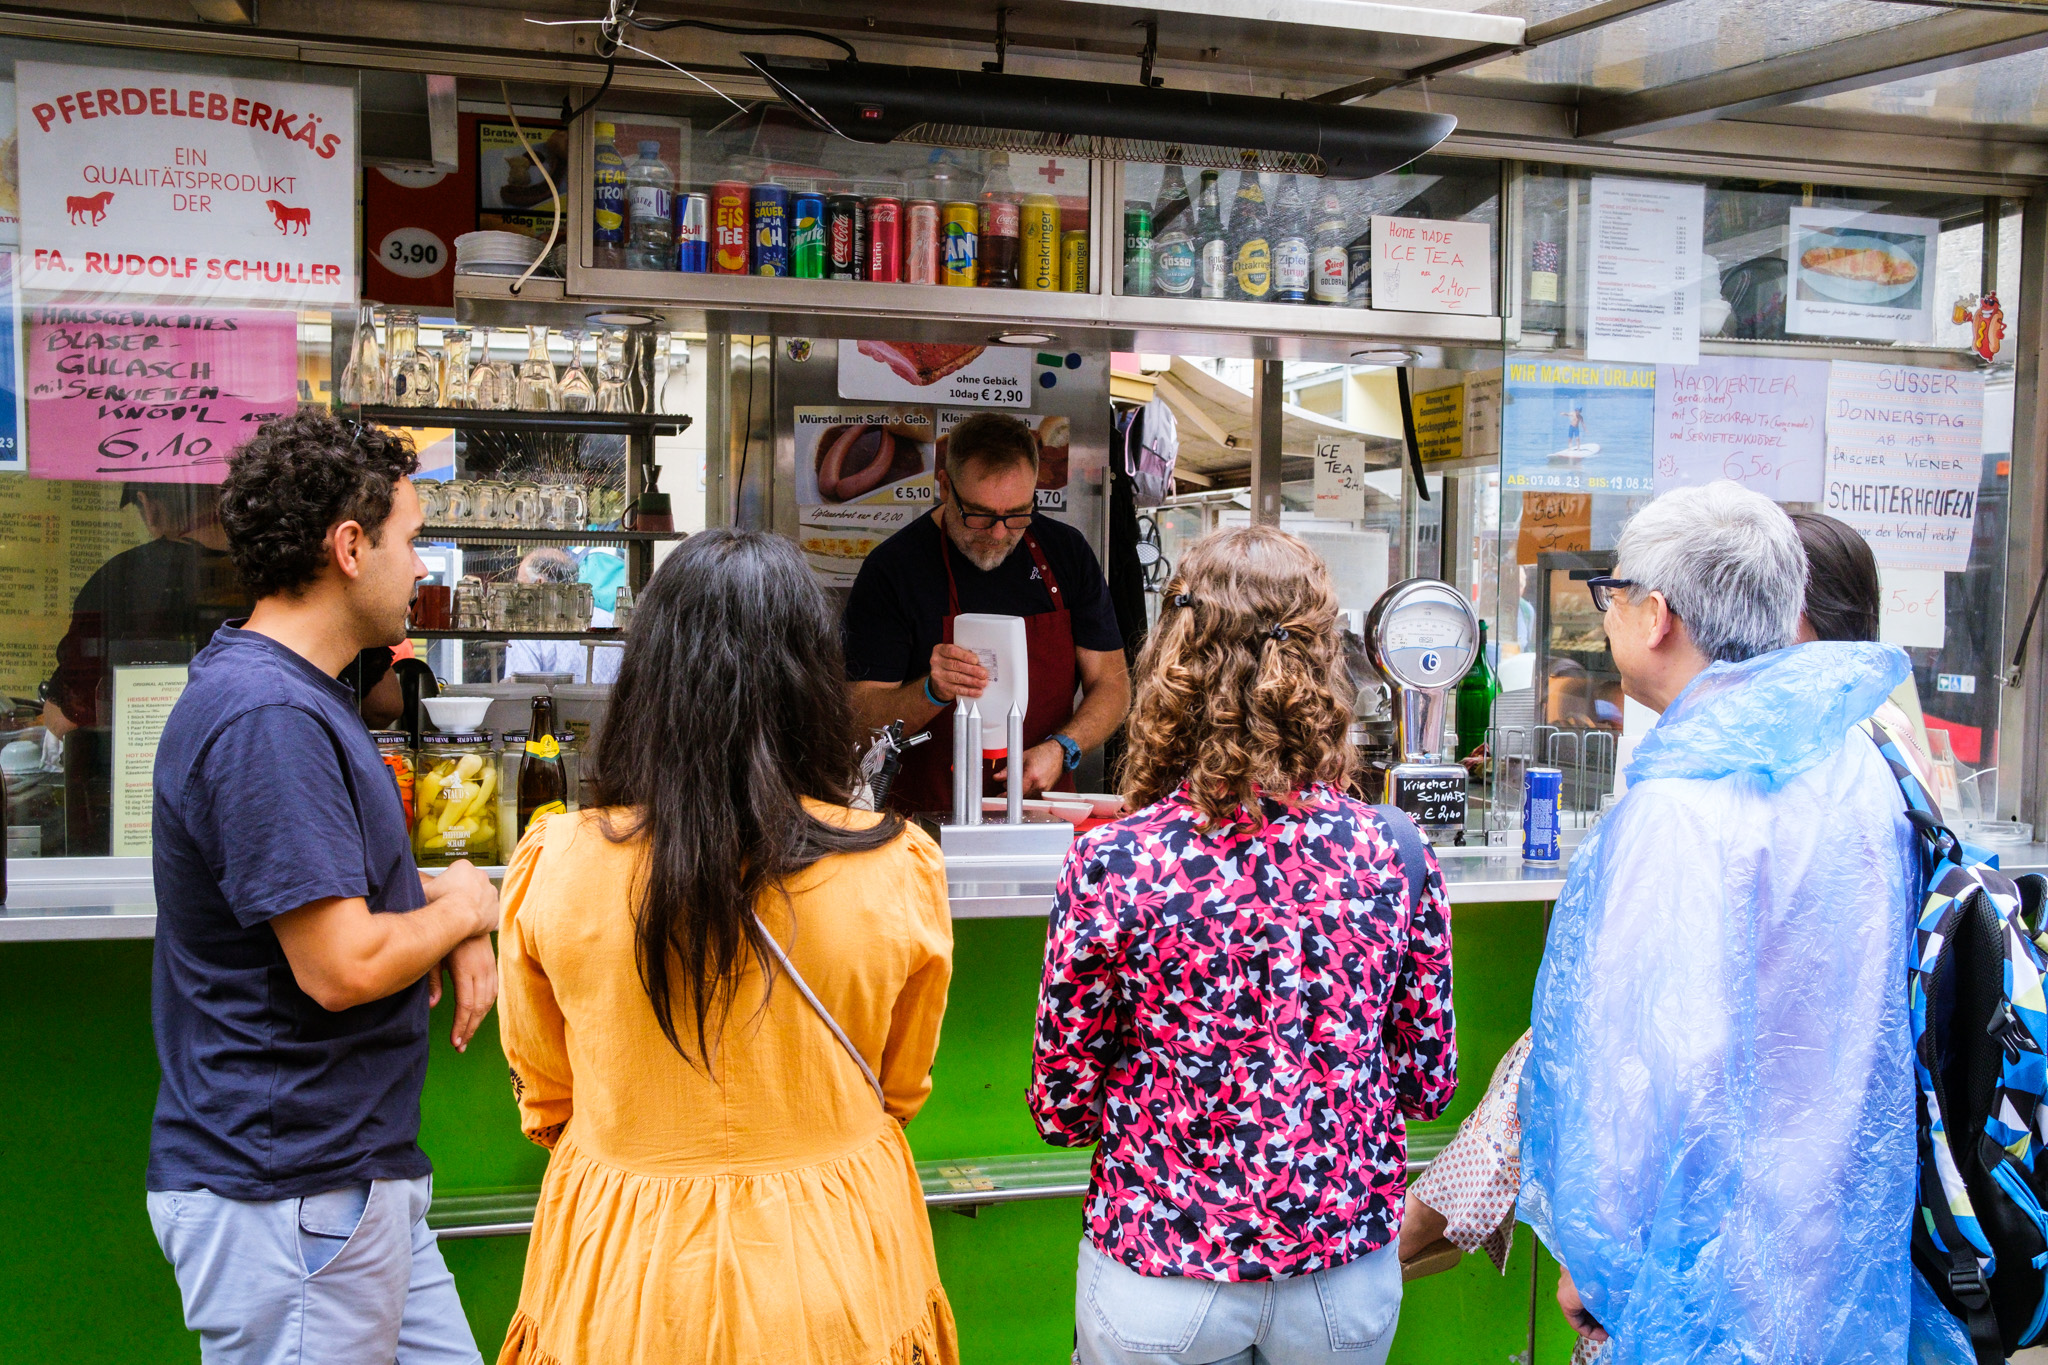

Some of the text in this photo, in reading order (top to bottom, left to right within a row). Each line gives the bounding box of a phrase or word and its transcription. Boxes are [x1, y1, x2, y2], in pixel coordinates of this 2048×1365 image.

[32, 88, 341, 160] PFERDELEBERKÄS
[175, 147, 207, 167] EIN
[83, 165, 297, 195] QUALITÄTSPRODUKT
[172, 194, 212, 213] DER
[790, 226, 826, 250] Sprite
[389, 241, 438, 264] 3,90
[1037, 211, 1053, 289] Ottakringer
[1384, 243, 1464, 268] ICE TEA
[34, 249, 341, 286] FA. RUDOLF SCHULLER
[1160, 252, 1192, 270] Gösser
[1279, 255, 1307, 267] Zipfer
[1325, 258, 1344, 272] Stiegl
[56, 354, 215, 380] GULASCH
[1510, 364, 1536, 382] WIR
[1540, 366, 1599, 385] MACHEN
[957, 375, 1018, 386] ohne Gebäck
[1672, 367, 1799, 397] WALDVIERTLER
[1876, 368, 1959, 394] SÜSSER
[949, 389, 1023, 404] 10dag € 2,90
[799, 414, 842, 424] Würstel
[845, 414, 864, 424] mit
[866, 414, 890, 424] Saft
[904, 415, 930, 424] Geb.
[1836, 399, 1965, 428] DONNERSTAG
[97, 428, 213, 462] 6,10
[1875, 435, 1896, 446] AB
[1317, 444, 1340, 459] ICE
[1904, 452, 1963, 470] WIENER
[1324, 460, 1353, 474] TEA
[1507, 474, 1529, 486] AB:
[1588, 477, 1609, 488] BIS:
[895, 487, 931, 500] € 5,10
[1828, 482, 1975, 519] SCHEITERHAUFEN
[881, 513, 904, 523] 2,00
[1875, 524, 1891, 538] der
[1896, 521, 1928, 542] Vorrat
[1438, 805, 1461, 822] 2,40
